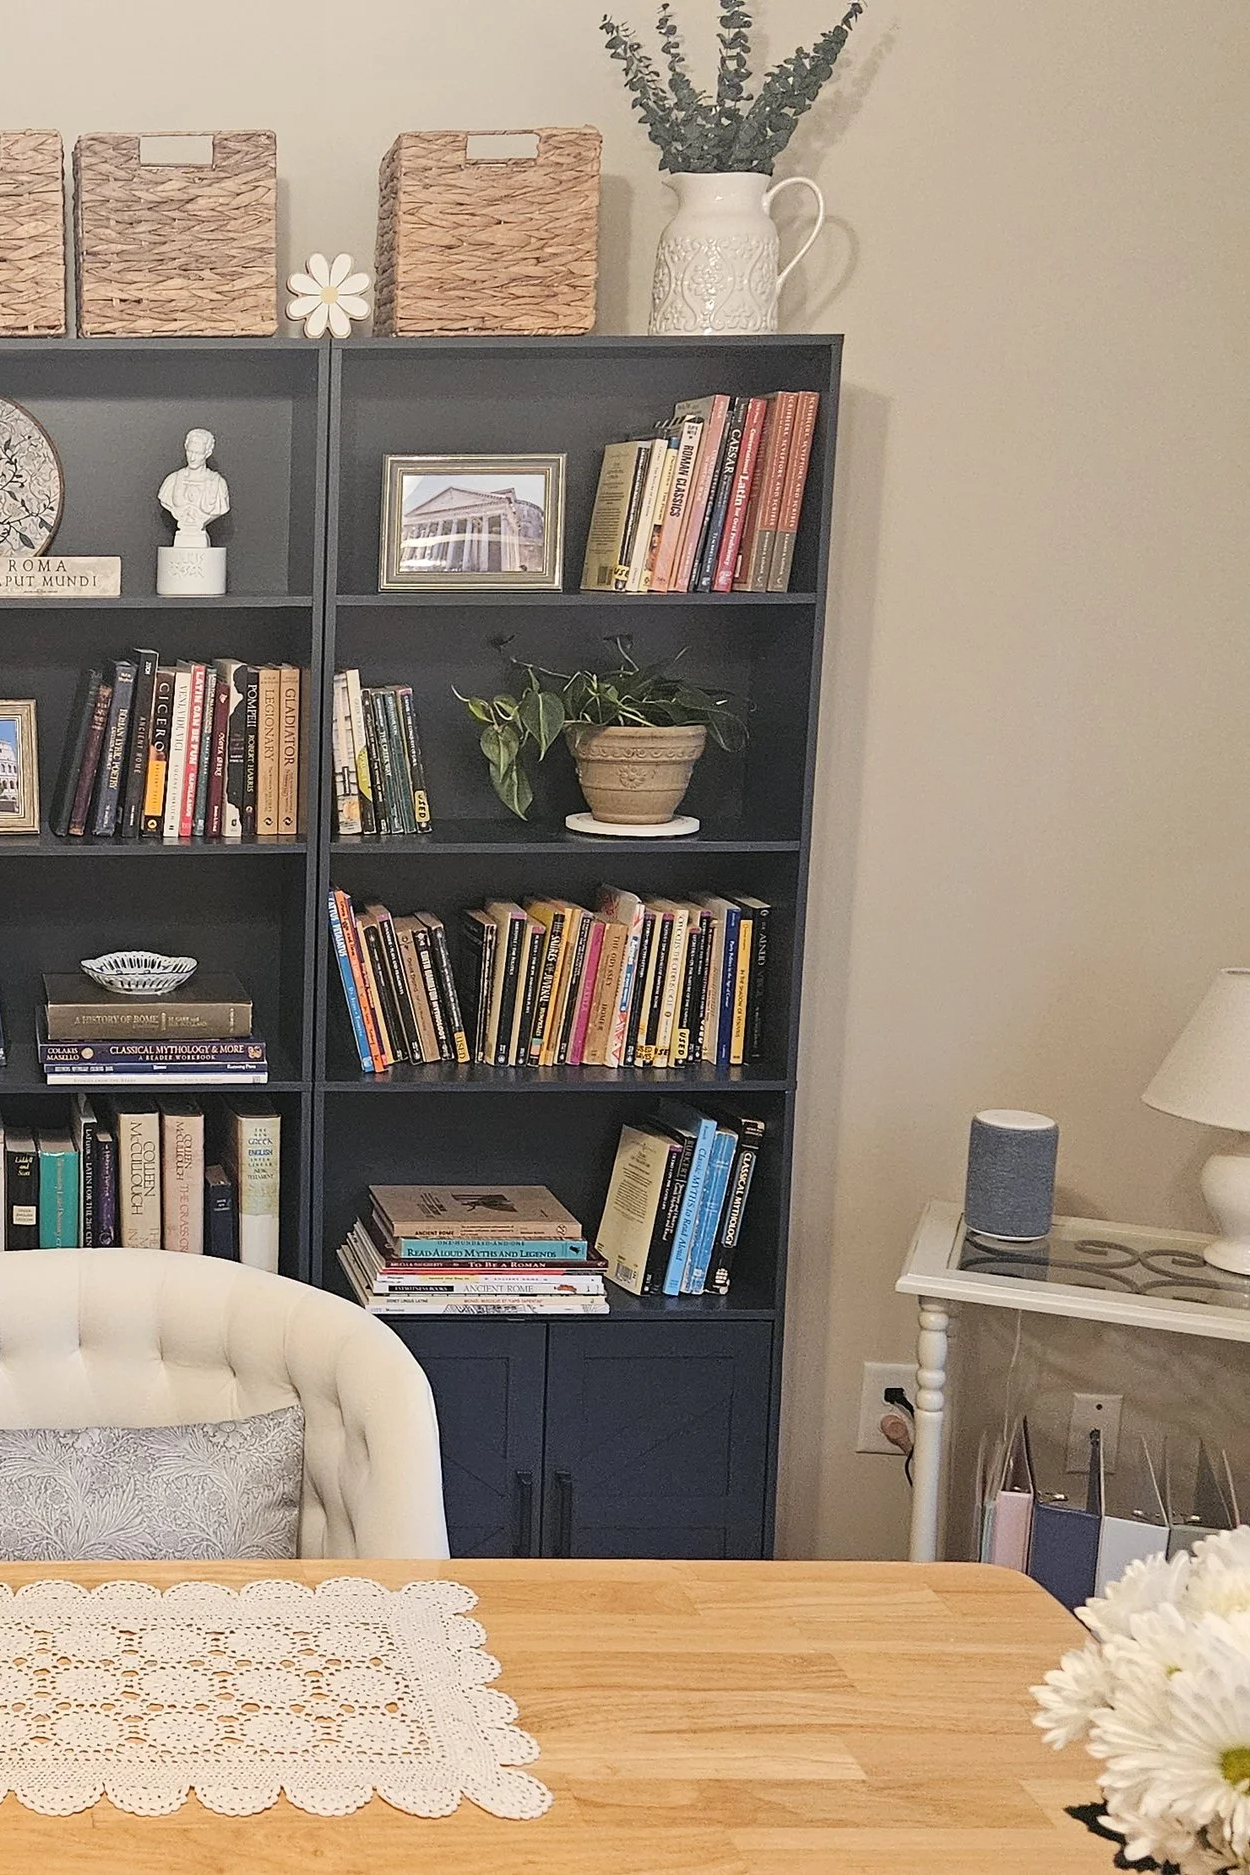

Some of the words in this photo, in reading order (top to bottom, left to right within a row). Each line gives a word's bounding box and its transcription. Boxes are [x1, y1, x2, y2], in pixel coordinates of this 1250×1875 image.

[677, 443, 693, 476] ROMAN
[723, 427, 742, 475] CAESAR
[669, 477, 686, 517] CLASSICS
[733, 473, 749, 507] Latin
[730, 517, 739, 531] Oral
[8, 559, 68, 572] ROMA
[42, 576, 97, 587] MUNDI
[193, 670, 203, 703] LATIN
[152, 681, 170, 752] CICERO
[191, 705, 201, 726] CAN
[246, 684, 257, 727] POMPEII
[135, 715, 146, 748] ANCIENT
[190, 728, 199, 741] BE
[263, 689, 275, 761] LEGIONARY
[283, 688, 295, 765] GLADIATOR
[133, 752, 142, 774] ROME
[188, 742, 198, 765] FUN
[108, 760, 120, 790] POETRY
[611, 935, 620, 950] THE
[604, 952, 617, 987] ODYSSEY
[538, 971, 552, 1003] JUVENAL
[736, 985, 744, 1006] SHADOW
[82, 1015, 119, 1024] HISTORY
[120, 1015, 131, 1023] OF
[133, 1015, 159, 1023] ROME
[431, 1000, 446, 1040] MYTHOLOGY
[597, 1002, 608, 1032] HOMER
[110, 1046, 154, 1055] CLASSICAL
[155, 1045, 210, 1055] MYTHOLOGY
[211, 1045, 219, 1054] &
[219, 1044, 244, 1054] MORE
[454, 1034, 467, 1060] USED
[676, 1031, 687, 1056] USED
[175, 1121, 183, 1181] McCULLOUGH
[694, 1147, 707, 1174] Classic
[129, 1121, 143, 1215] McCULLOUGH
[142, 1140, 156, 1197] COLLEEN
[737, 1152, 752, 1195] CLASSICAL
[179, 1183, 188, 1203] THE
[686, 1174, 701, 1208] MYTHS
[179, 1204, 188, 1236] GRASS
[680, 1217, 691, 1237] Read
[684, 1208, 693, 1217] to
[725, 1195, 741, 1245] MYTHOLOGY
[464, 1249, 500, 1258] MYTHS
[519, 1250, 557, 1258] LEGENDS
[674, 1237, 687, 1262] Aloud
[463, 1285, 505, 1293] ANCIENT
[506, 1285, 533, 1293] ROME
